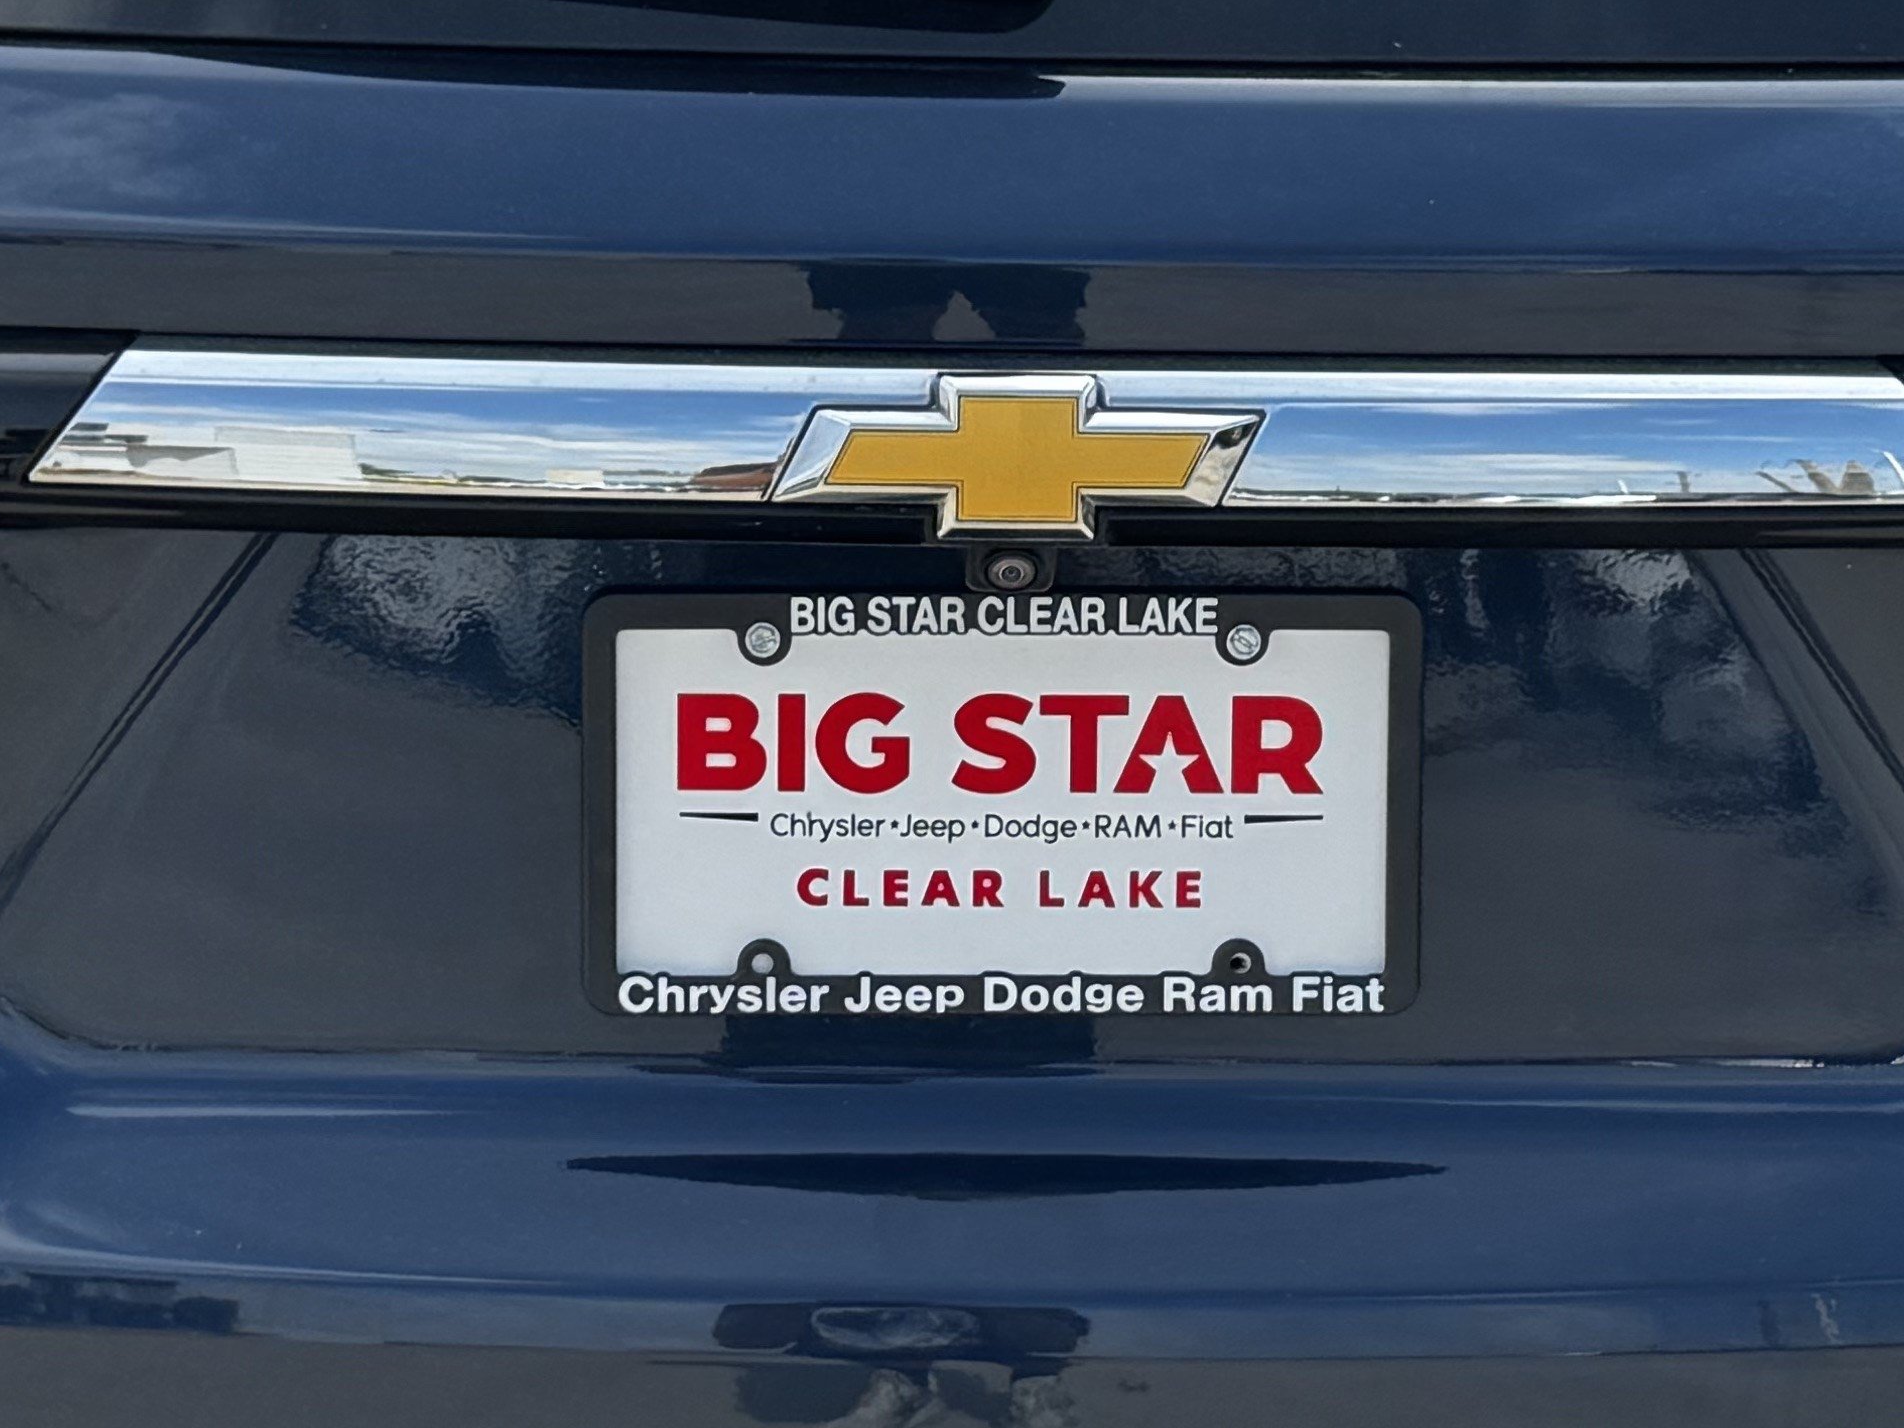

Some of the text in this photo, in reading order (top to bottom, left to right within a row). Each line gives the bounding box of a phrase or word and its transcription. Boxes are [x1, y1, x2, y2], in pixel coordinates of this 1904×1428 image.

[790, 596, 1219, 634] BIG STAR CLEAR LAKE
[676, 692, 1324, 796] BIG STAR
[769, 812, 1234, 845] Chrysler Jeep Dodge RAM Fiat
[796, 868, 1203, 909] CLEAR LAKE
[618, 975, 1385, 1014] Chrysler Jeep Dodge Ram Fiat
